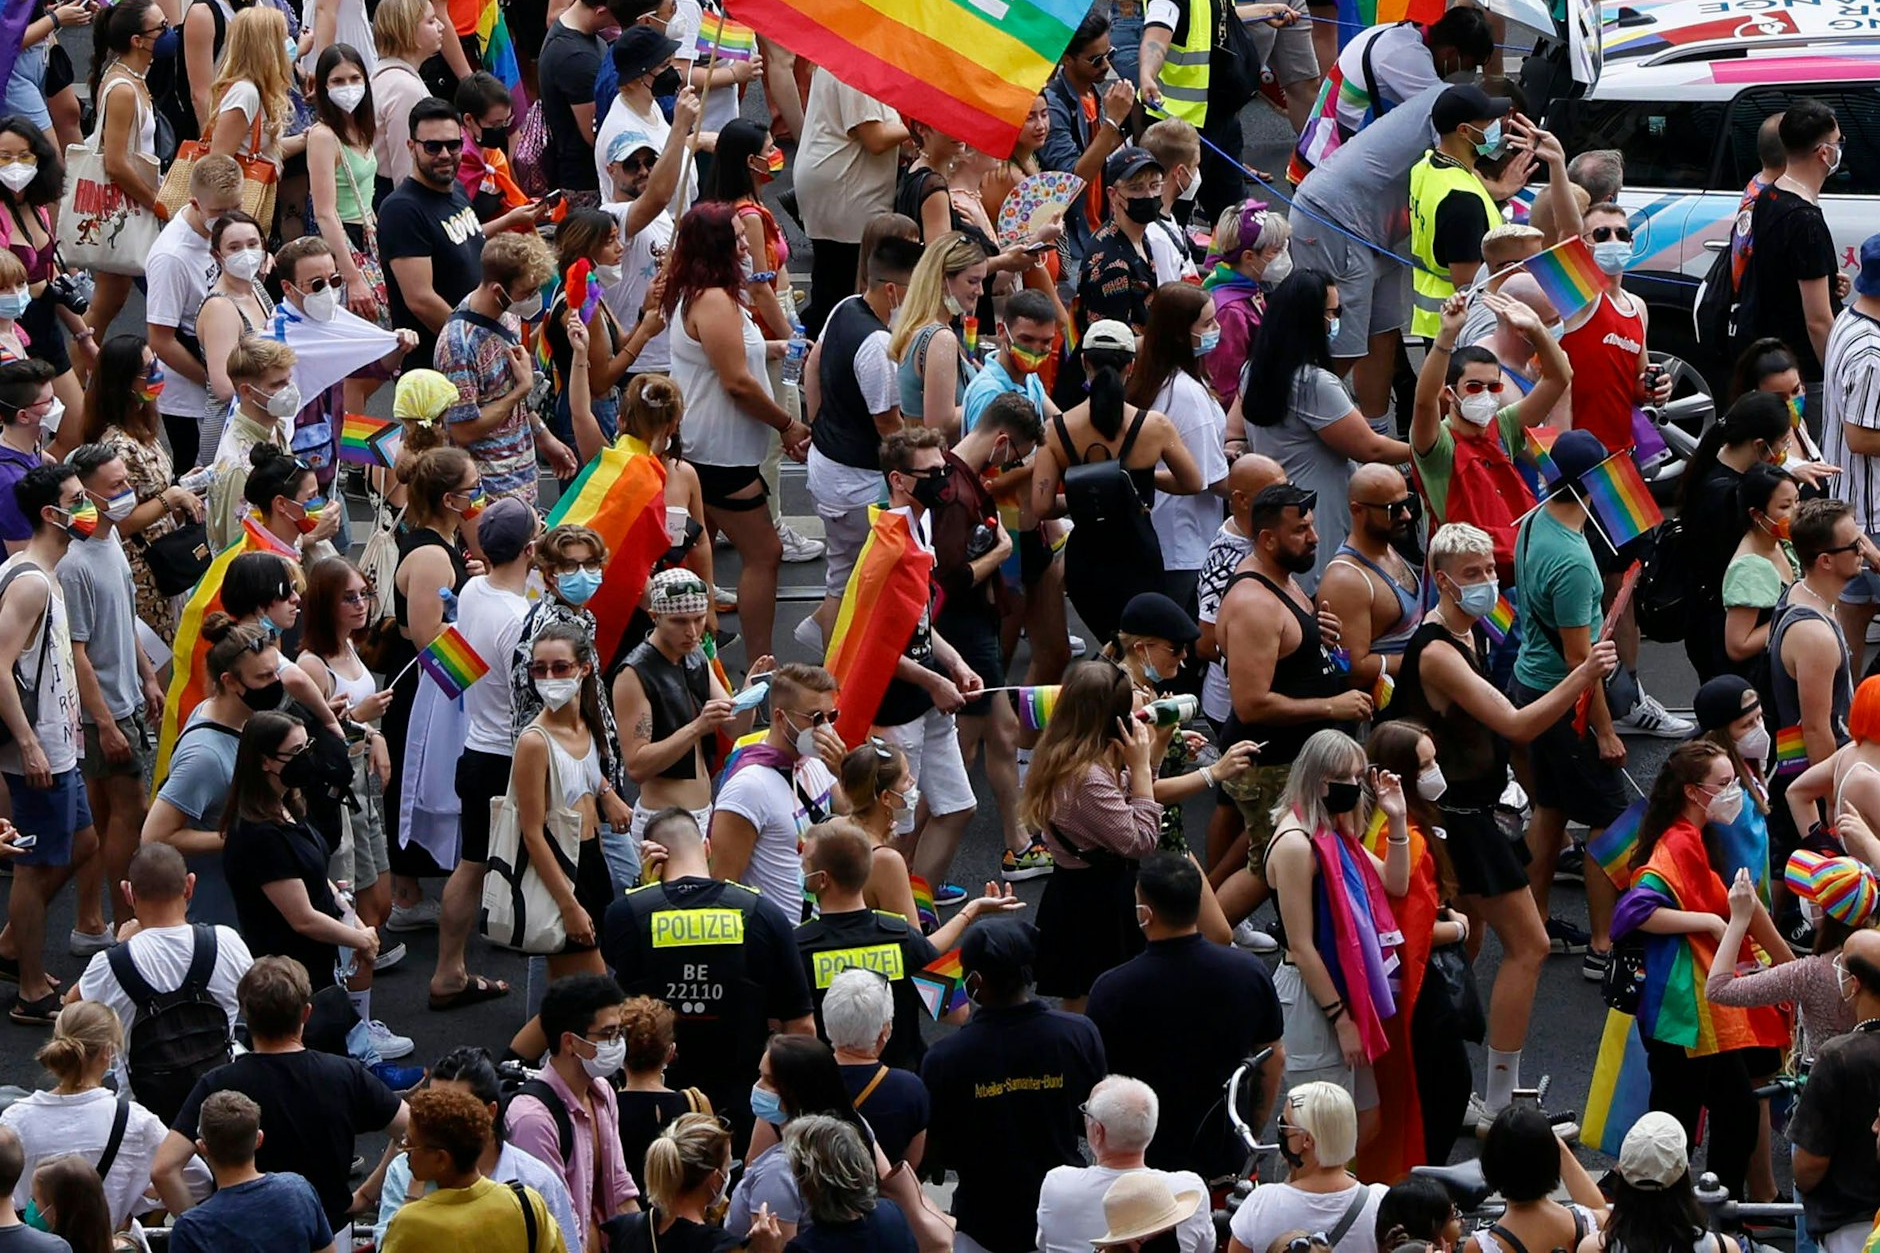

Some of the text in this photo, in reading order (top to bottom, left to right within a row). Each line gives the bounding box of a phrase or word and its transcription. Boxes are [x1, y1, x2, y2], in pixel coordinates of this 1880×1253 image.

[441, 206, 483, 245] LOVE
[656, 914, 738, 941] POLIZEI
[683, 964, 709, 981] BE
[666, 983, 723, 1000] 22110
